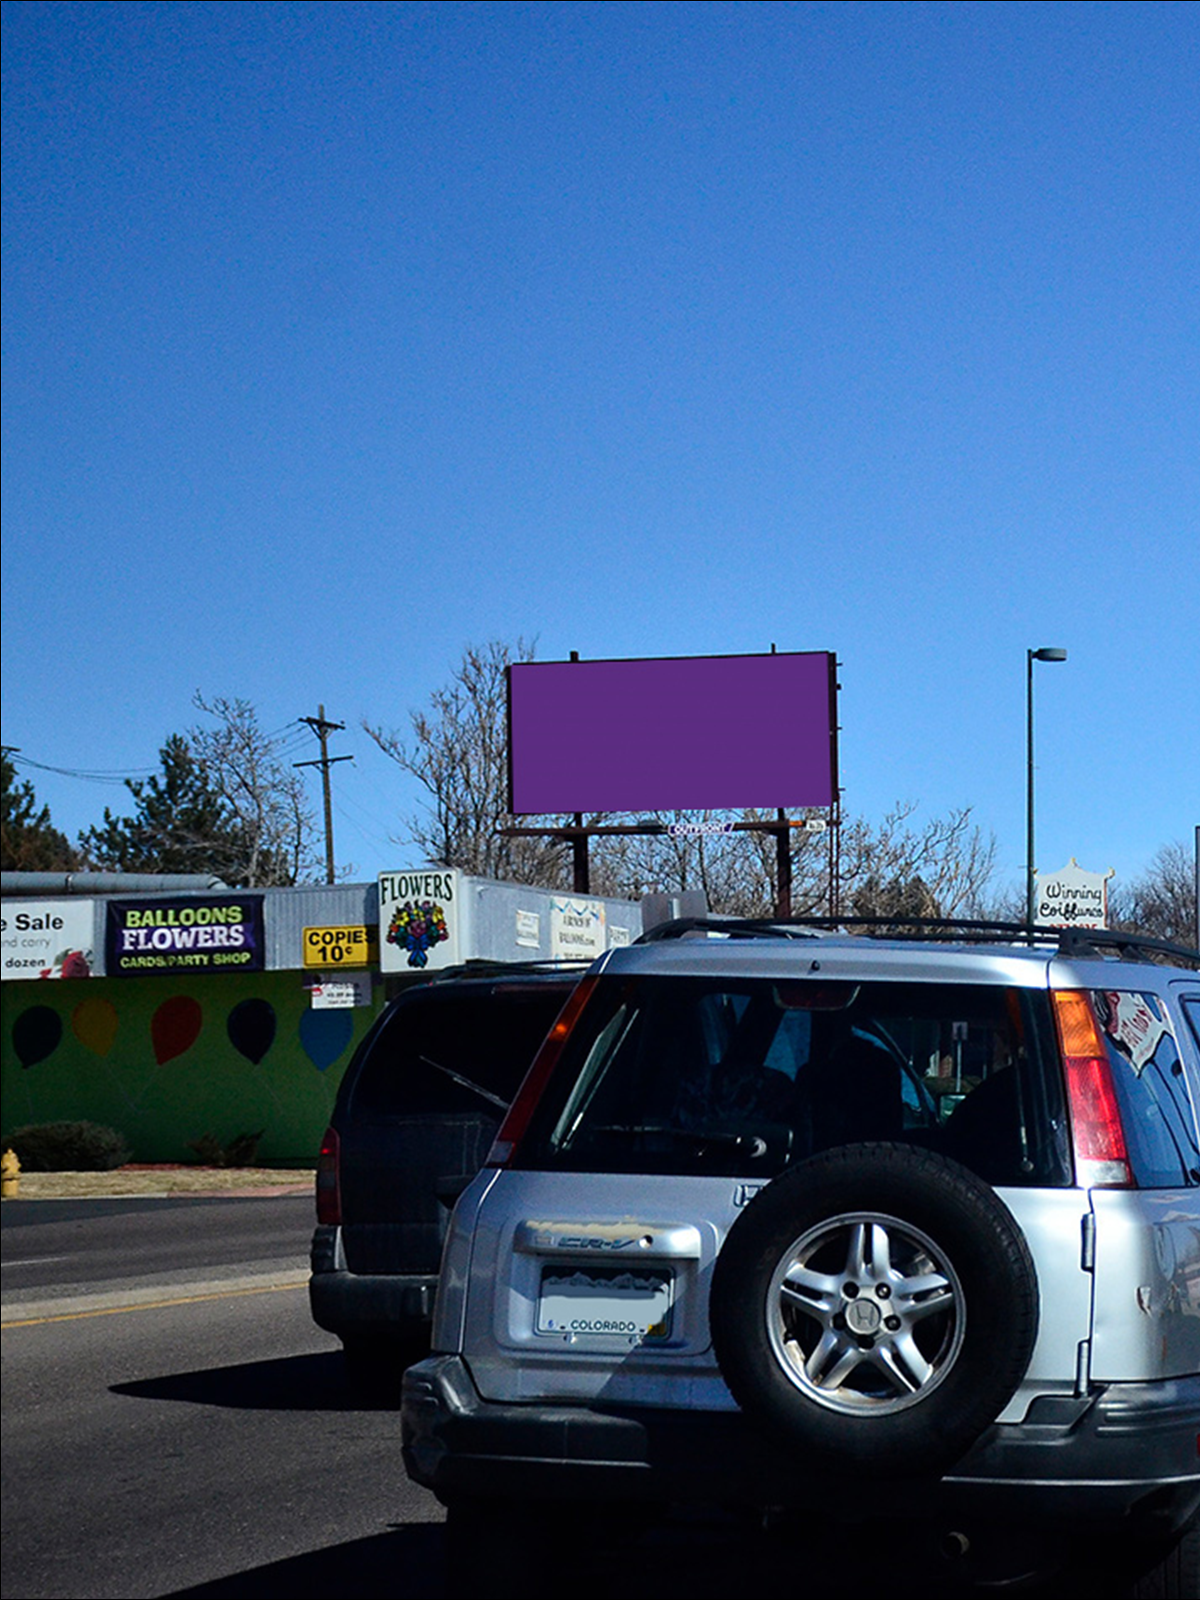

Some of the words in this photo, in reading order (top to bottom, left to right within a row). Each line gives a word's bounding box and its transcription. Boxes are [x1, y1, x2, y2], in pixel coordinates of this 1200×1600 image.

[381, 873, 453, 906] FLOWERS
[1046, 882, 1102, 906] Winning
[15, 913, 64, 931] Sale
[126, 905, 243, 928] BALLOONS
[122, 925, 245, 950] FLOWERS
[308, 929, 375, 946] COPIES
[5, 958, 46, 968] dozen
[212, 951, 251, 965] SHOP
[558, 1237, 636, 1249] CR-V
[570, 1320, 636, 1332] COLORADO
